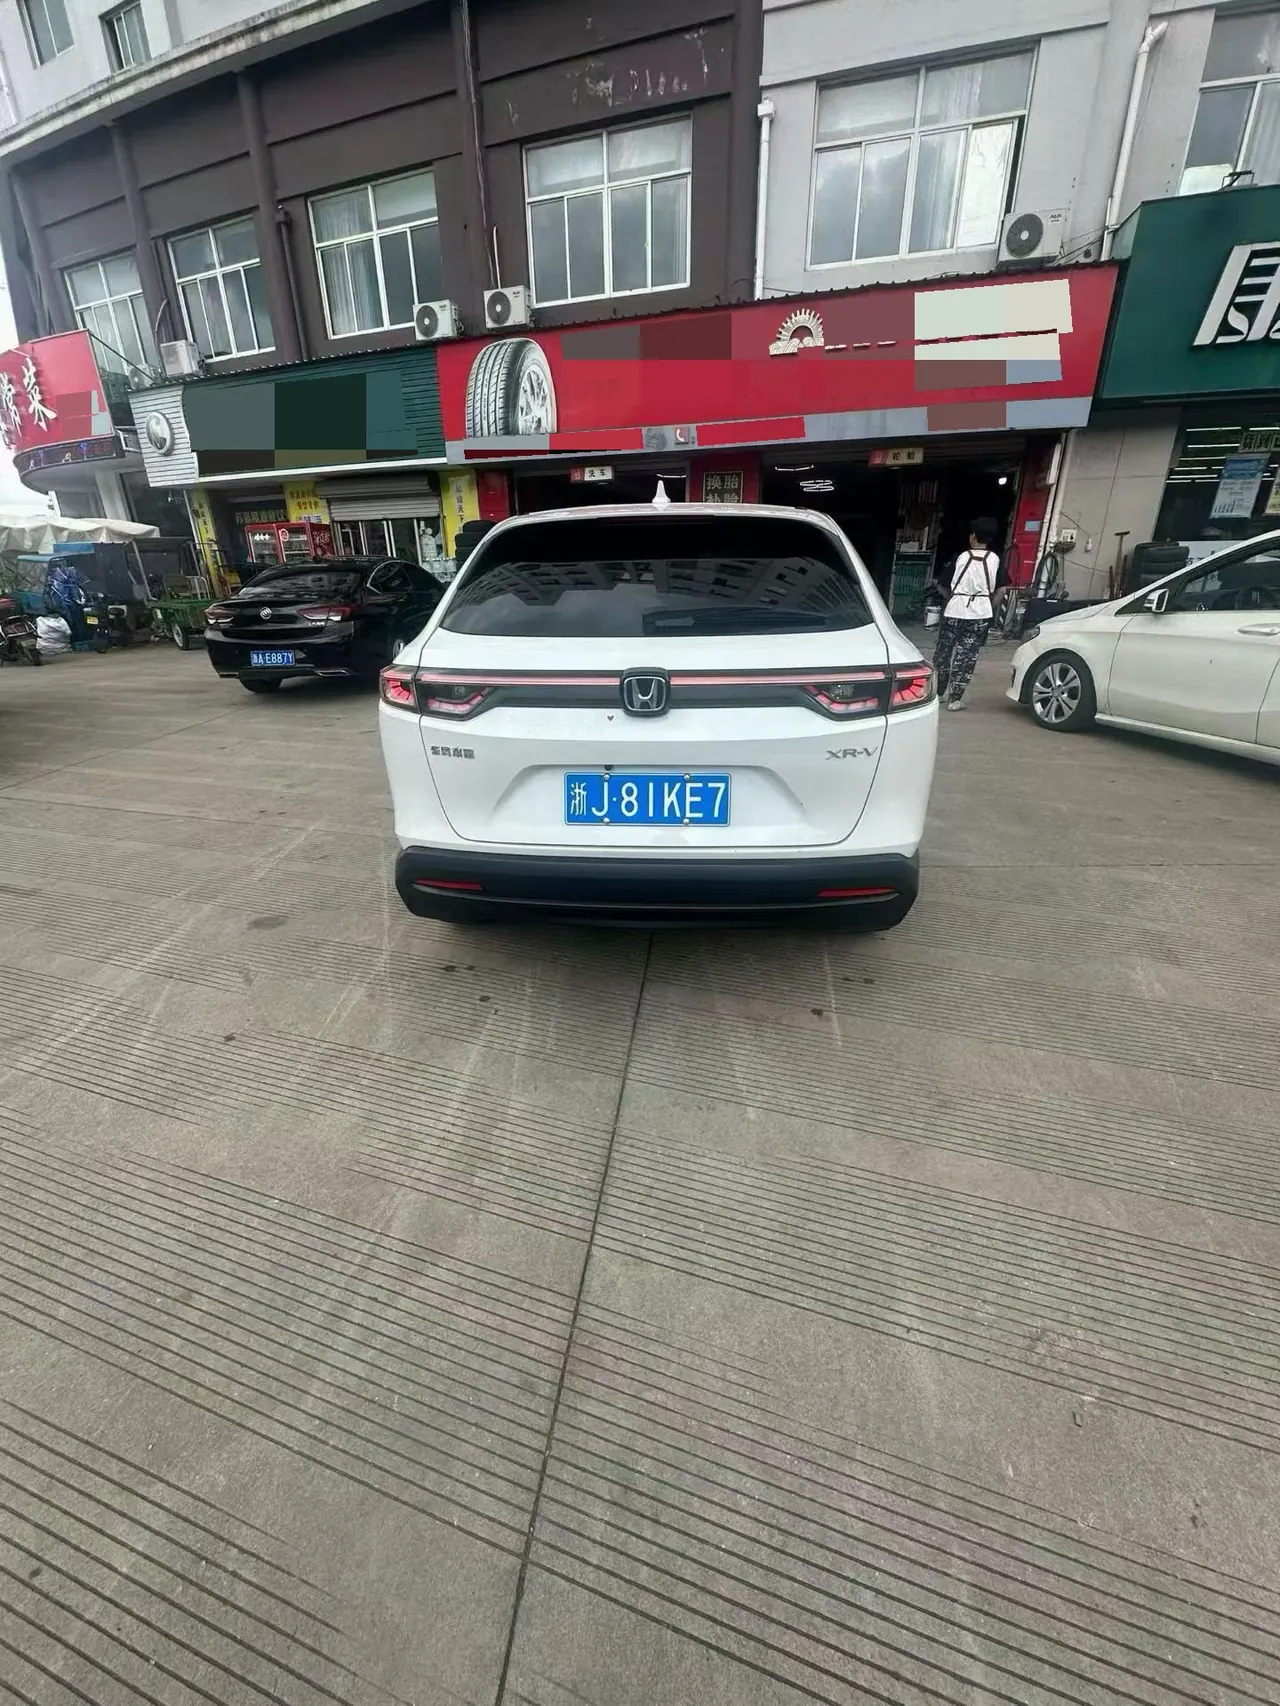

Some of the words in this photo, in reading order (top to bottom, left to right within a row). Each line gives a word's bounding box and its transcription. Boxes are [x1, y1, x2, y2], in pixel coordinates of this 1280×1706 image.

[588, 468, 606, 478] 洗车
[706, 474, 739, 490] 换胎
[825, 746, 878, 760] XR-V
[570, 781, 726, 818] 浙J·81KE7
